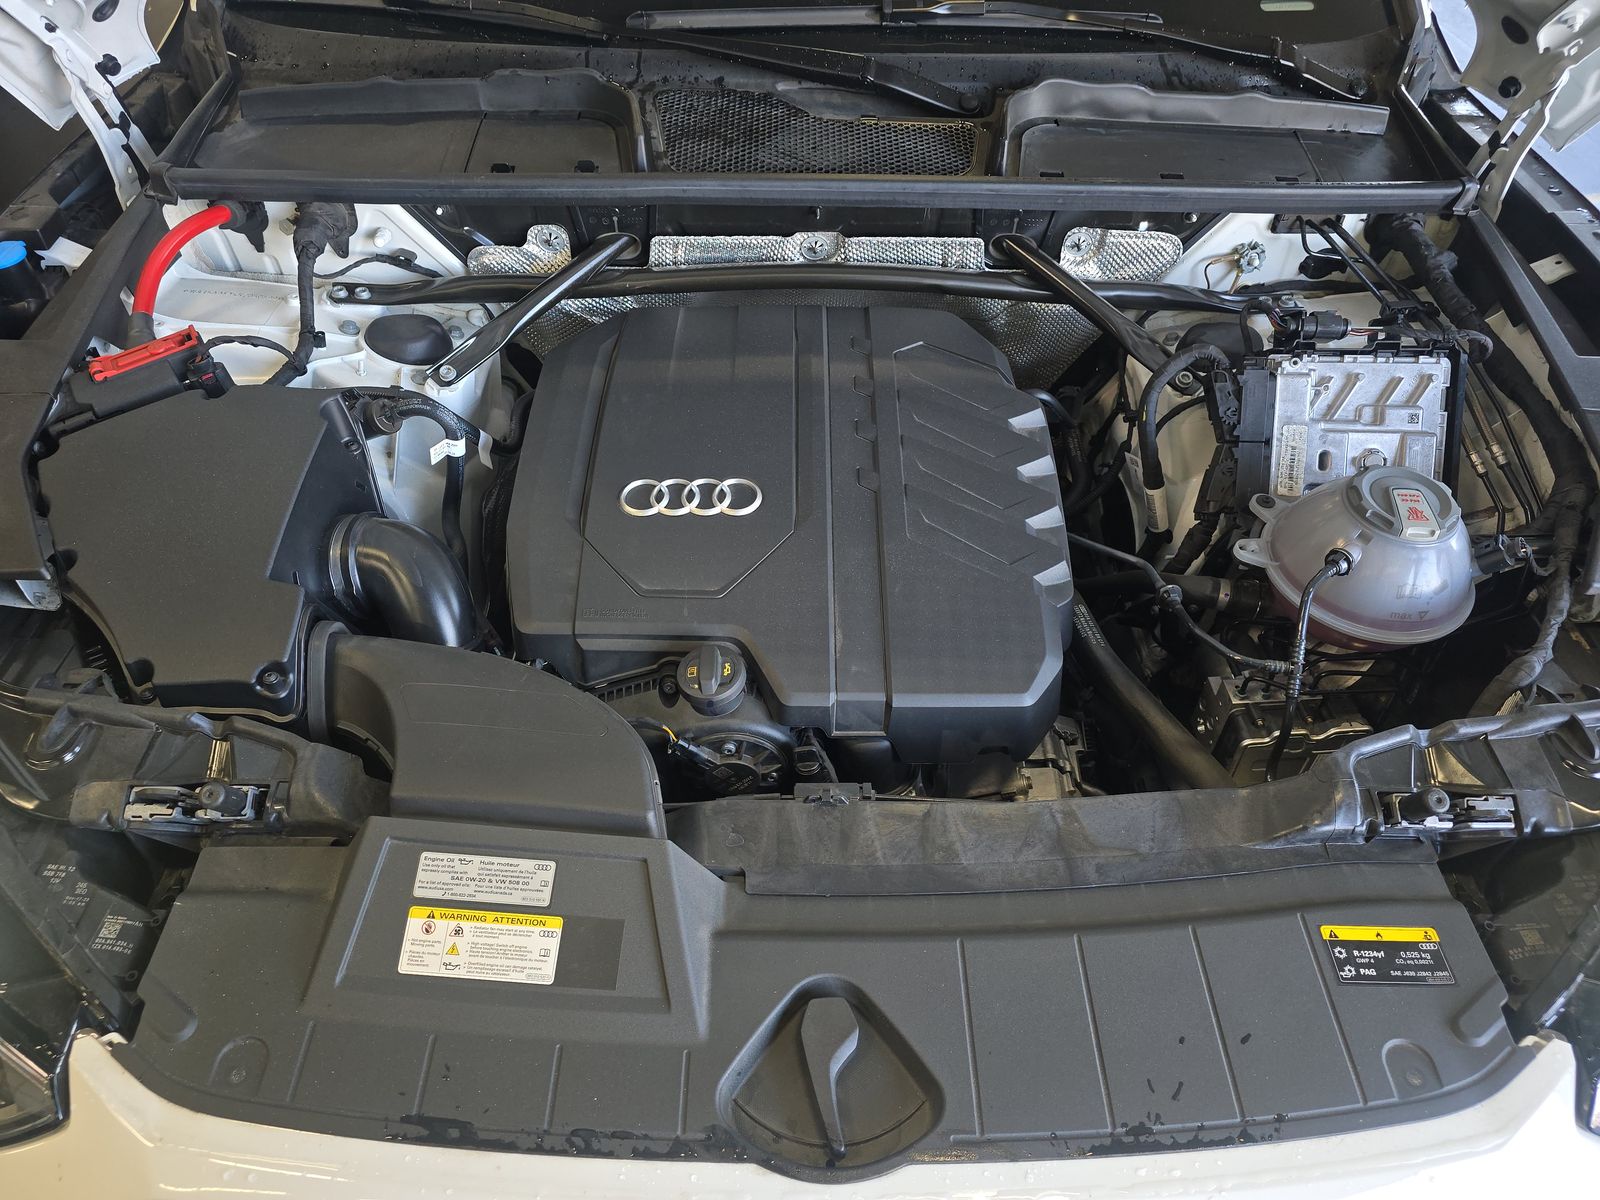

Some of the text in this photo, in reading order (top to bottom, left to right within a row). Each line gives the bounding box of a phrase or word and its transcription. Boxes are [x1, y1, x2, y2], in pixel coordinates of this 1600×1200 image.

[440, 912, 547, 926] WARNING ATTENTION
[1353, 950, 1384, 958] R-1234yf
